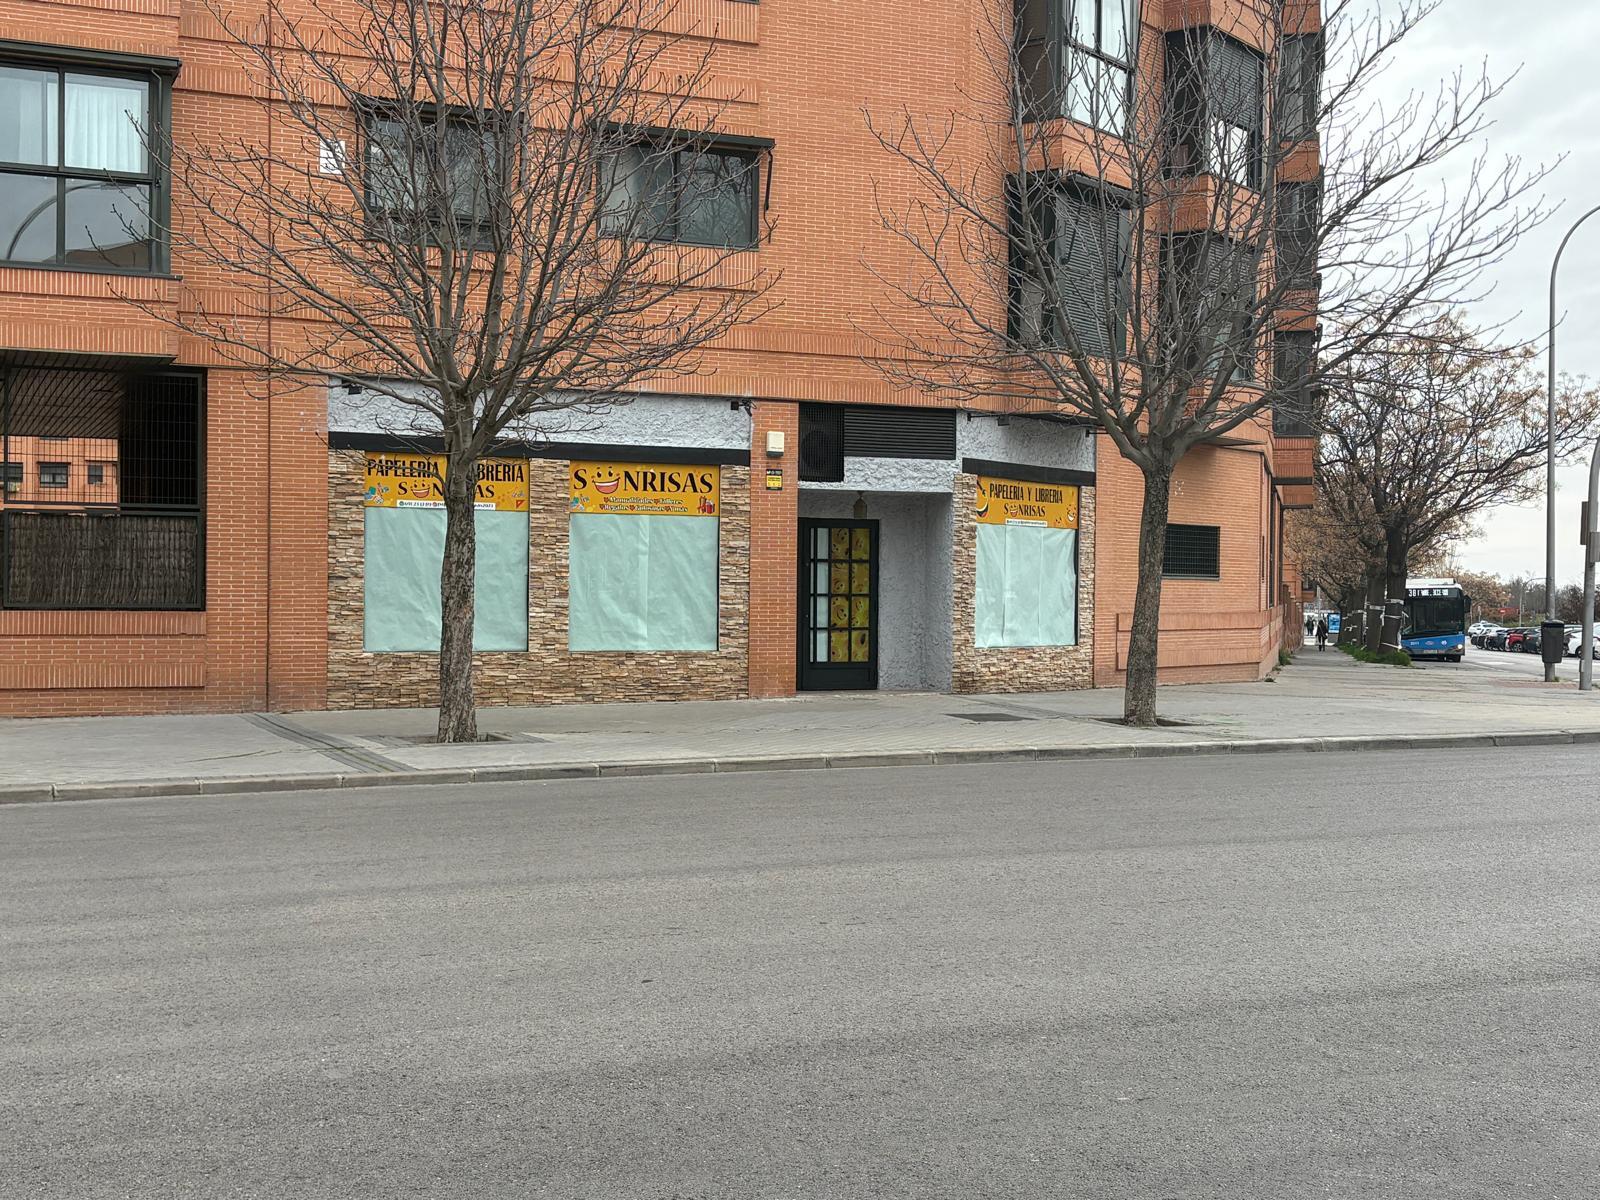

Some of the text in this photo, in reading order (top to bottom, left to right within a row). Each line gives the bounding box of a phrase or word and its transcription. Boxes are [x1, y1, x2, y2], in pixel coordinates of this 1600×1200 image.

[989, 482, 1063, 504] PAPELERÍA Y LIBRERÍA
